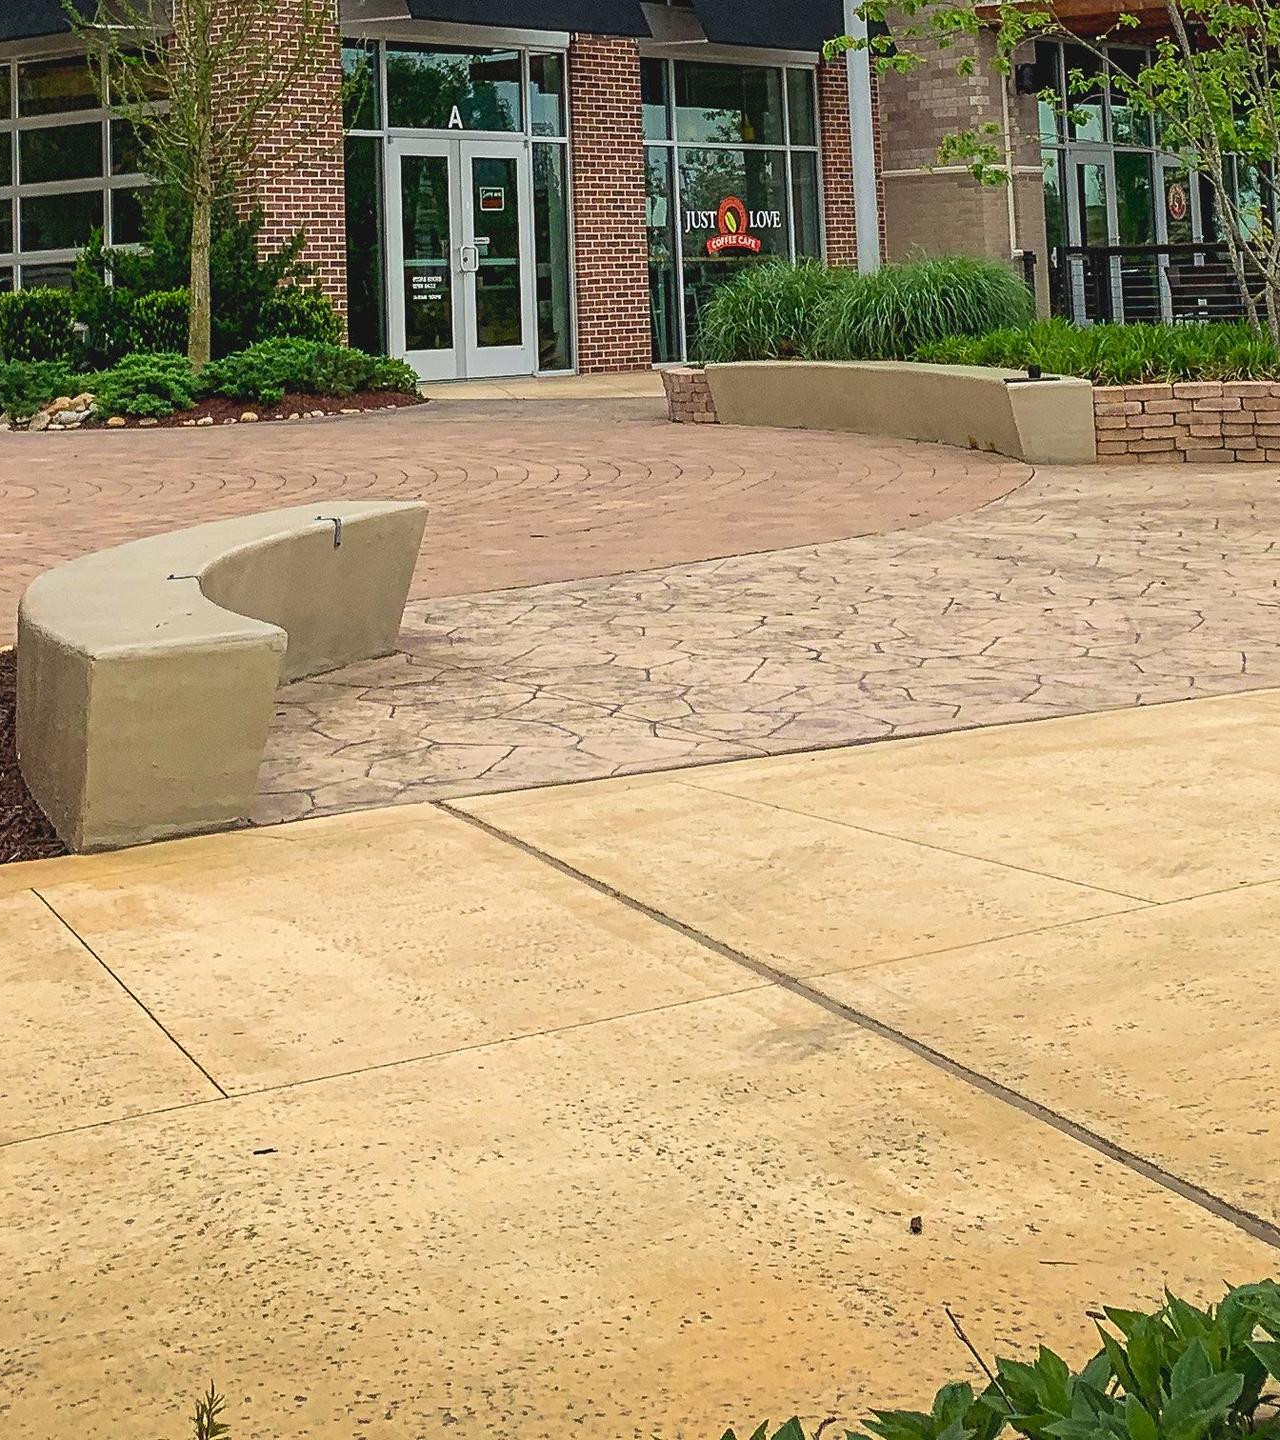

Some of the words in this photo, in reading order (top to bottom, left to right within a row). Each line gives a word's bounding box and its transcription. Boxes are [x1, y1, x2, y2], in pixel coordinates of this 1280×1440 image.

[448, 105, 463, 129] A
[685, 210, 718, 233] JUST
[749, 210, 782, 228] LOVE
[711, 235, 737, 249] COFFEE
[738, 235, 756, 248] CAFE
